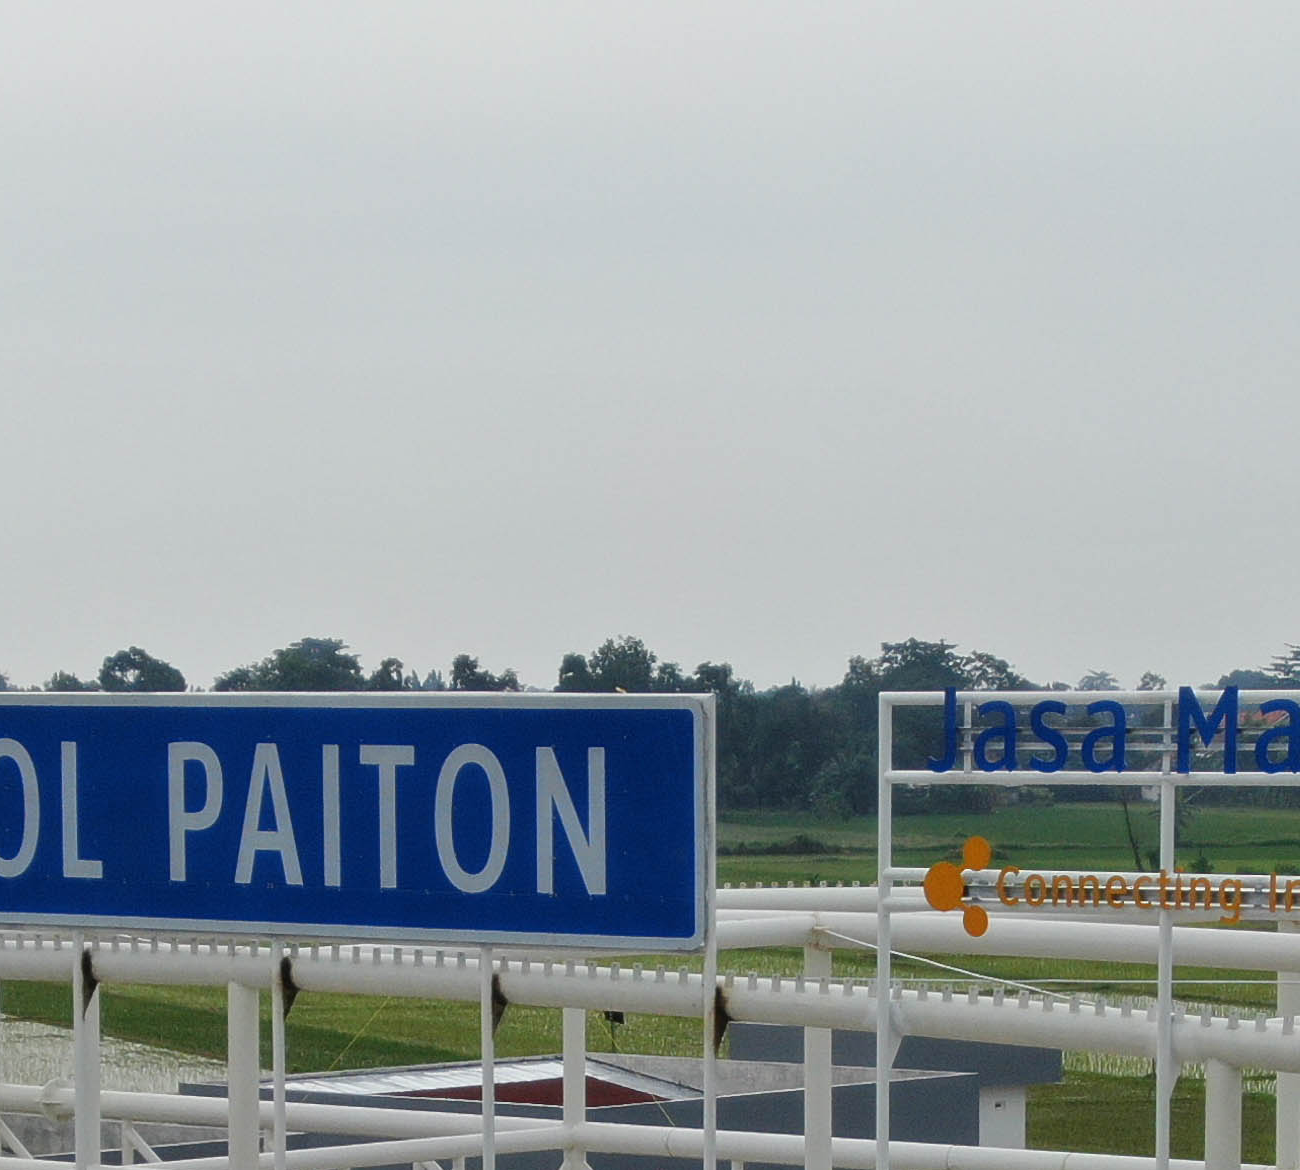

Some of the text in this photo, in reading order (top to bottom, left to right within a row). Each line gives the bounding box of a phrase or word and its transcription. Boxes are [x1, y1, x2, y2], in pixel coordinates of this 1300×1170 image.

[926, 686, 1132, 774] Jasa
[168, 741, 608, 895] PAITON
[995, 866, 1245, 925] Connecting
